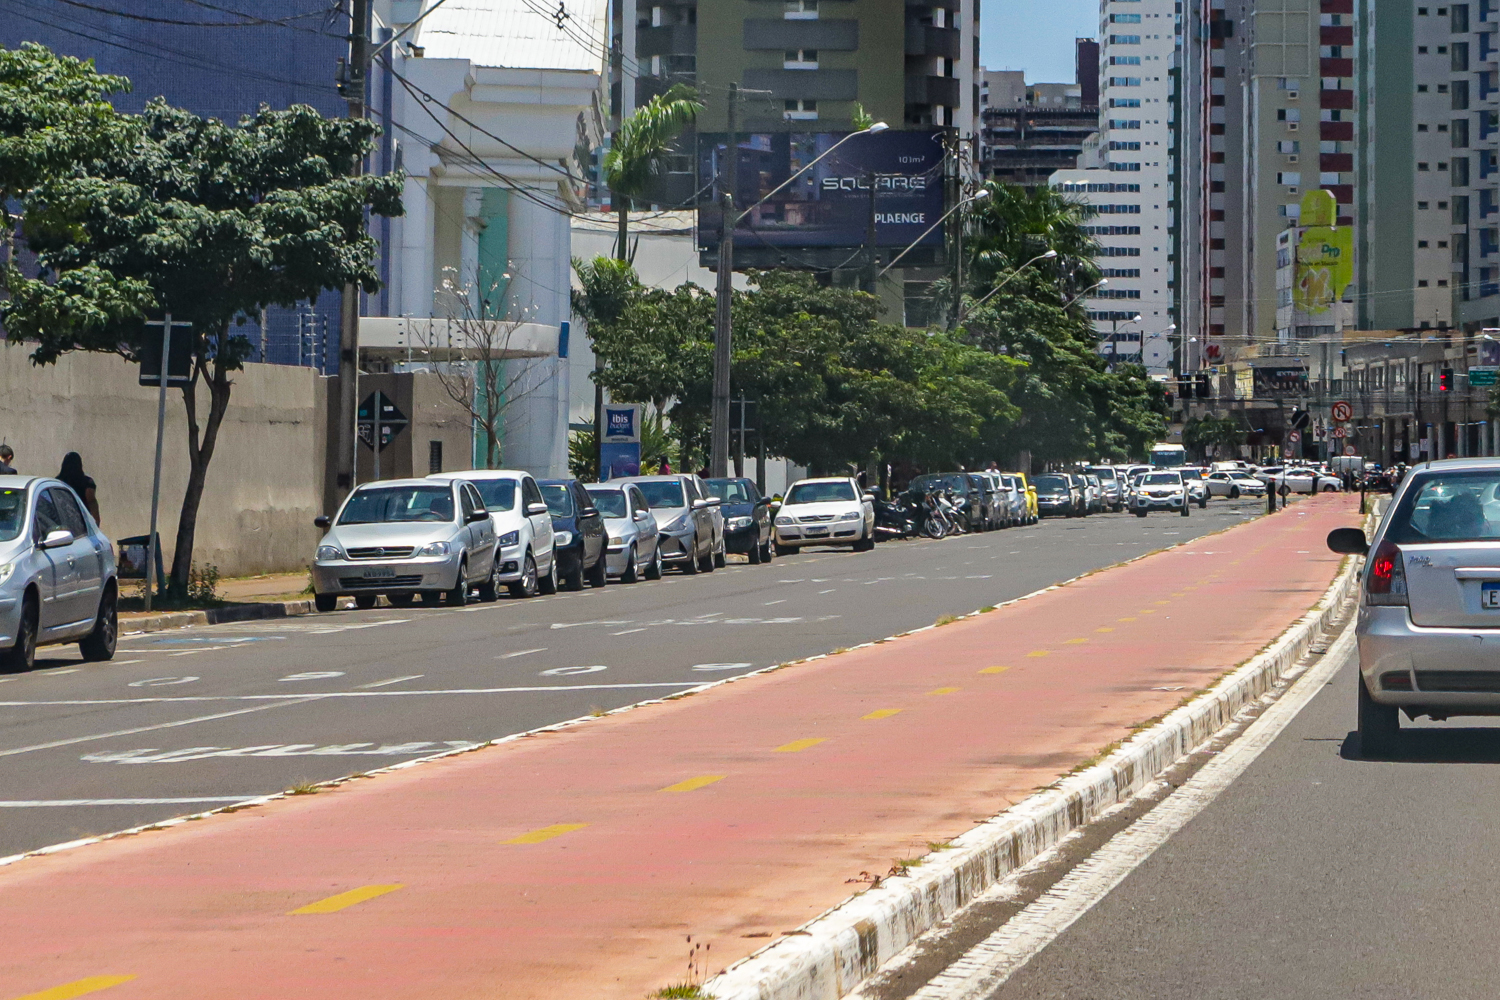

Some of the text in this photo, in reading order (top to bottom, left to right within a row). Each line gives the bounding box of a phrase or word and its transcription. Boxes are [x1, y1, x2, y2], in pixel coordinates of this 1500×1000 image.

[822, 176, 925, 191] SQUARE
[874, 212, 925, 223] PLAENGE
[612, 413, 629, 423] ibis
